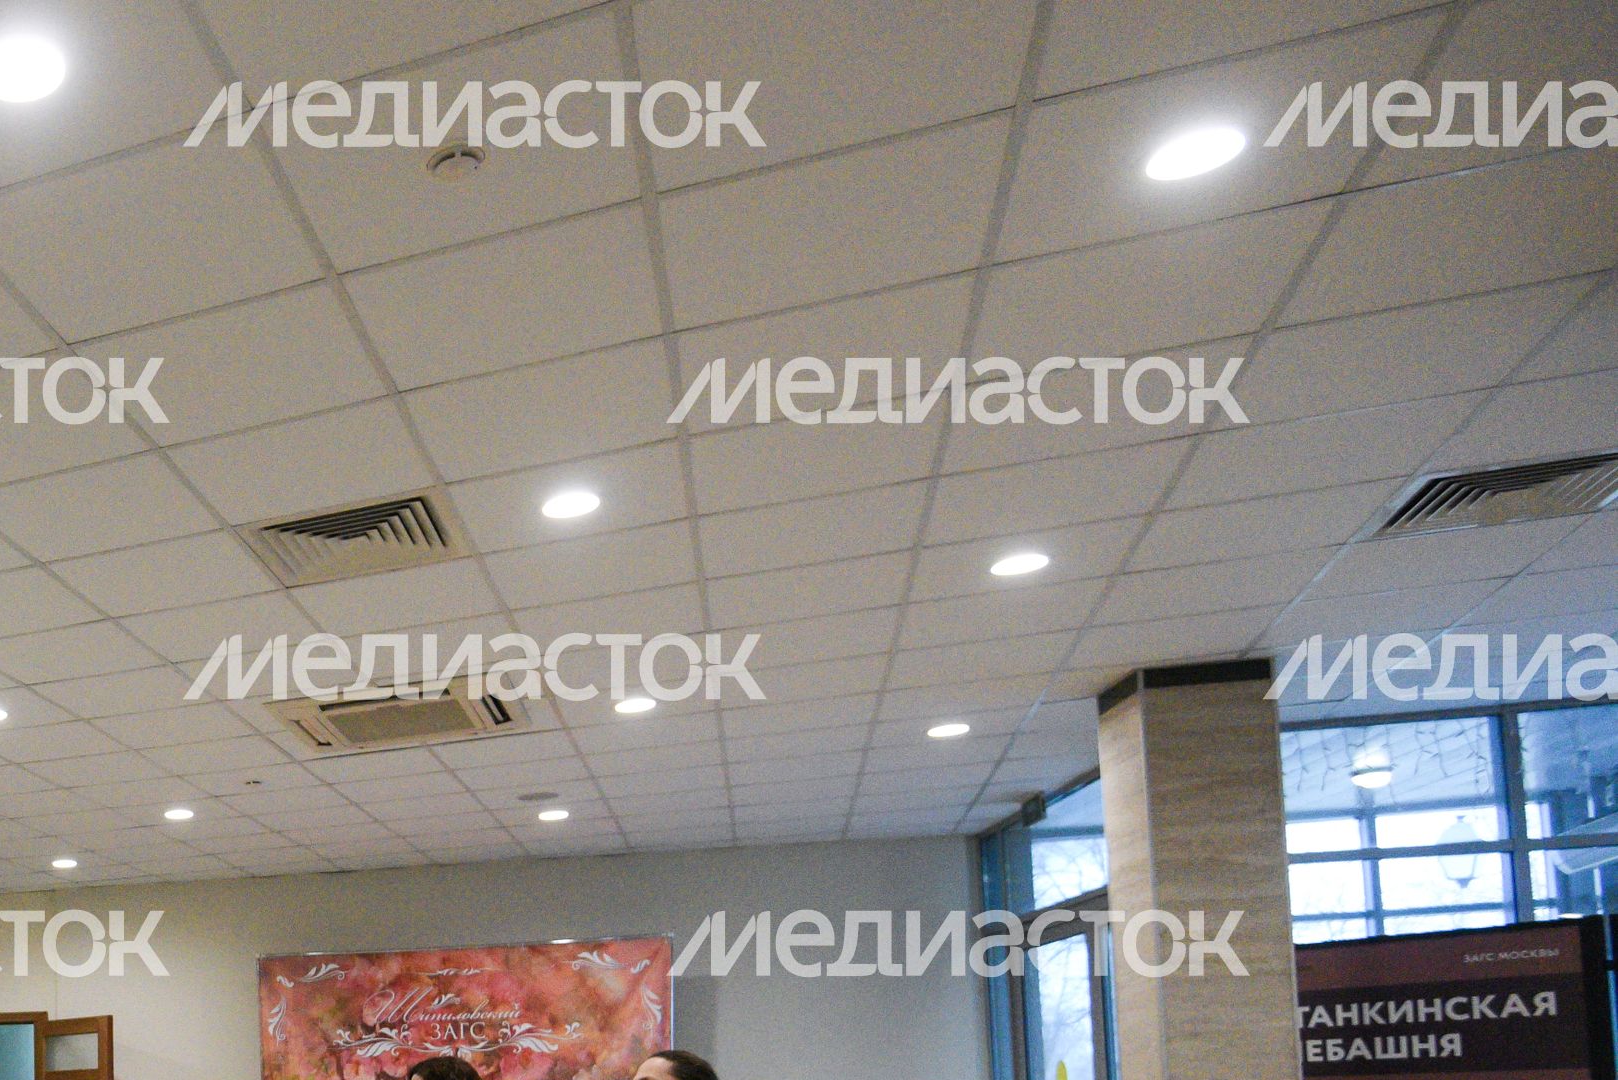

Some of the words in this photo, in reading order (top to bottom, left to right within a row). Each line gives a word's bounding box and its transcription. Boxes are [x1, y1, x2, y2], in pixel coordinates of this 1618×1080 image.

[1463, 952, 1495, 963] ЗАГС
[1498, 948, 1559, 961] МОСКВЫ
[430, 1021, 487, 1040] ЗАГС
